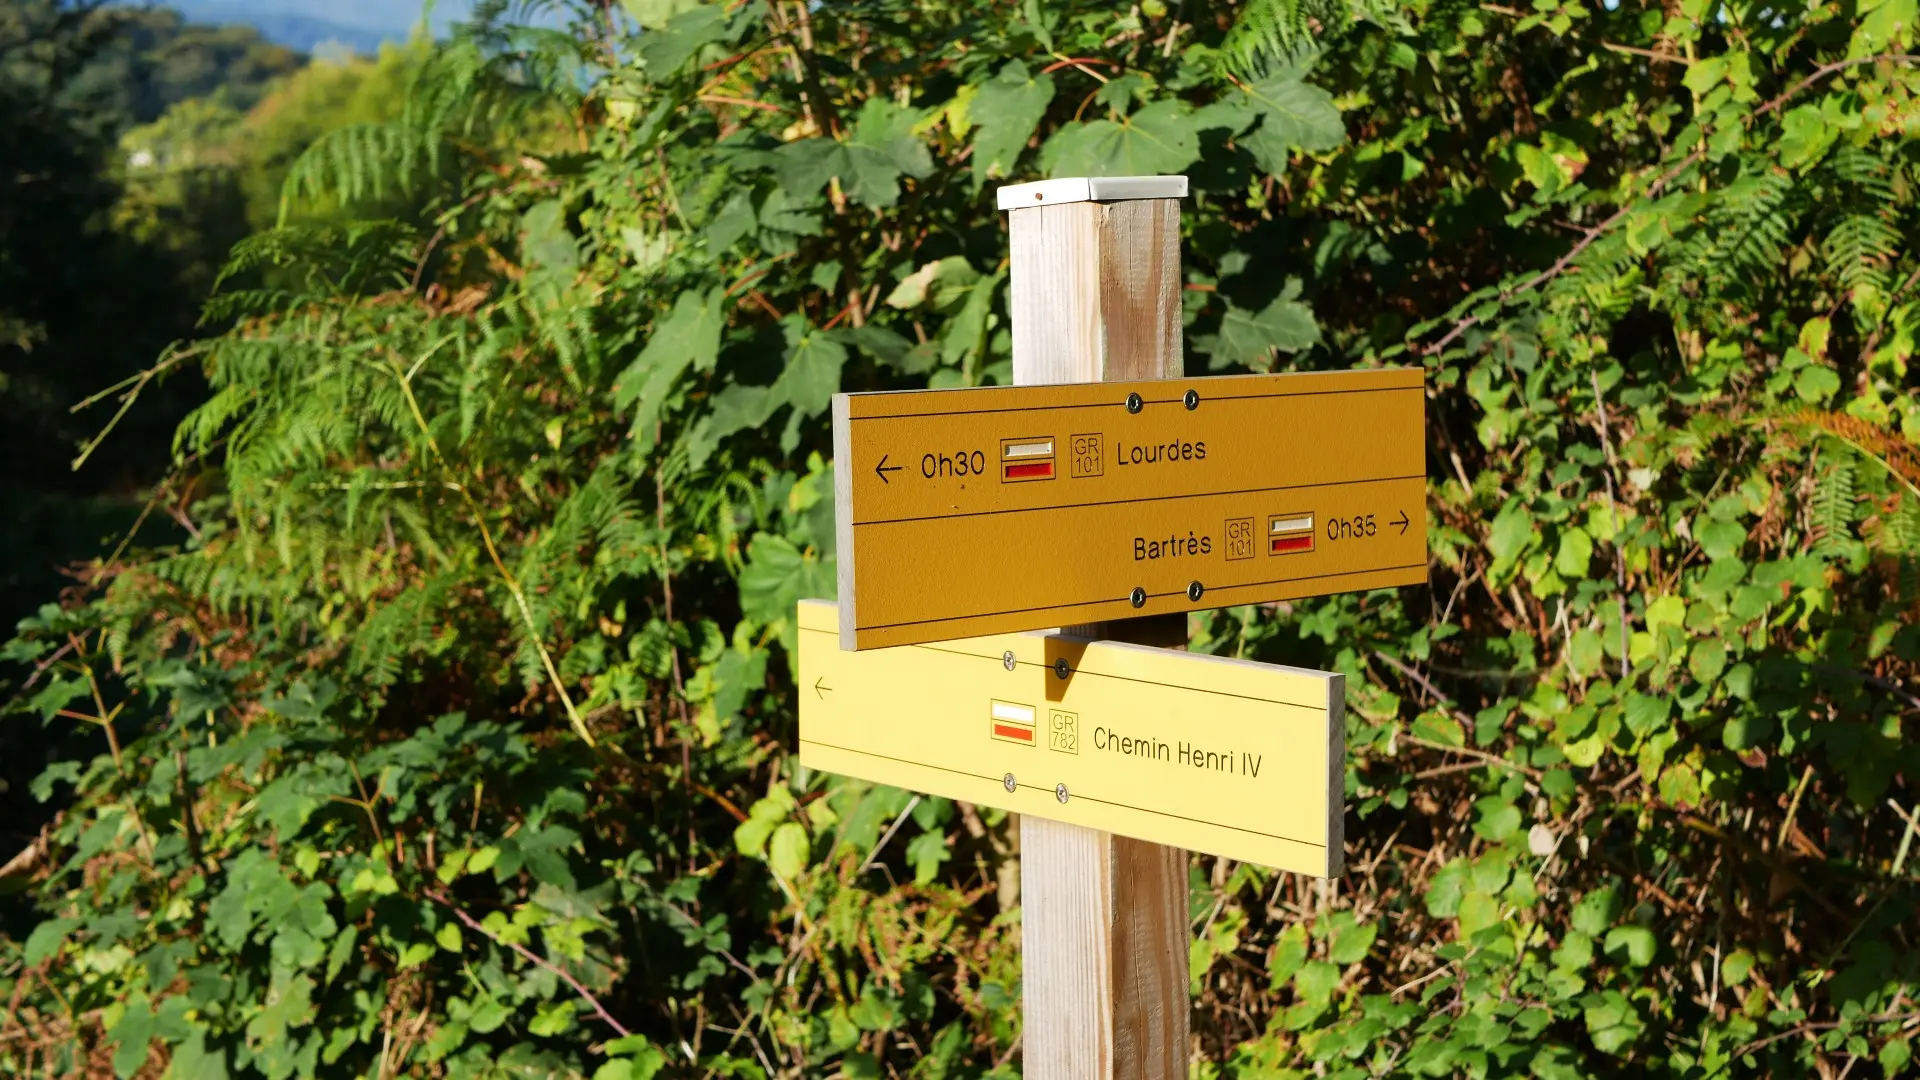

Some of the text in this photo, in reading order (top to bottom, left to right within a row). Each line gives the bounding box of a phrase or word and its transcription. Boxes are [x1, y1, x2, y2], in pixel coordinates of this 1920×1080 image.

[1074, 437, 1100, 456] GR
[1117, 438, 1207, 466] Lourdes
[921, 450, 985, 479] 0h30
[1074, 456, 1100, 474] 101
[1228, 522, 1251, 539] GR
[1327, 514, 1377, 541] 0h35
[1133, 531, 1212, 561] Bartrès
[1228, 539, 1252, 556] 101
[1052, 713, 1075, 732] GR
[1052, 731, 1076, 750] 782
[1094, 726, 1262, 778] Chemin Henri IV
